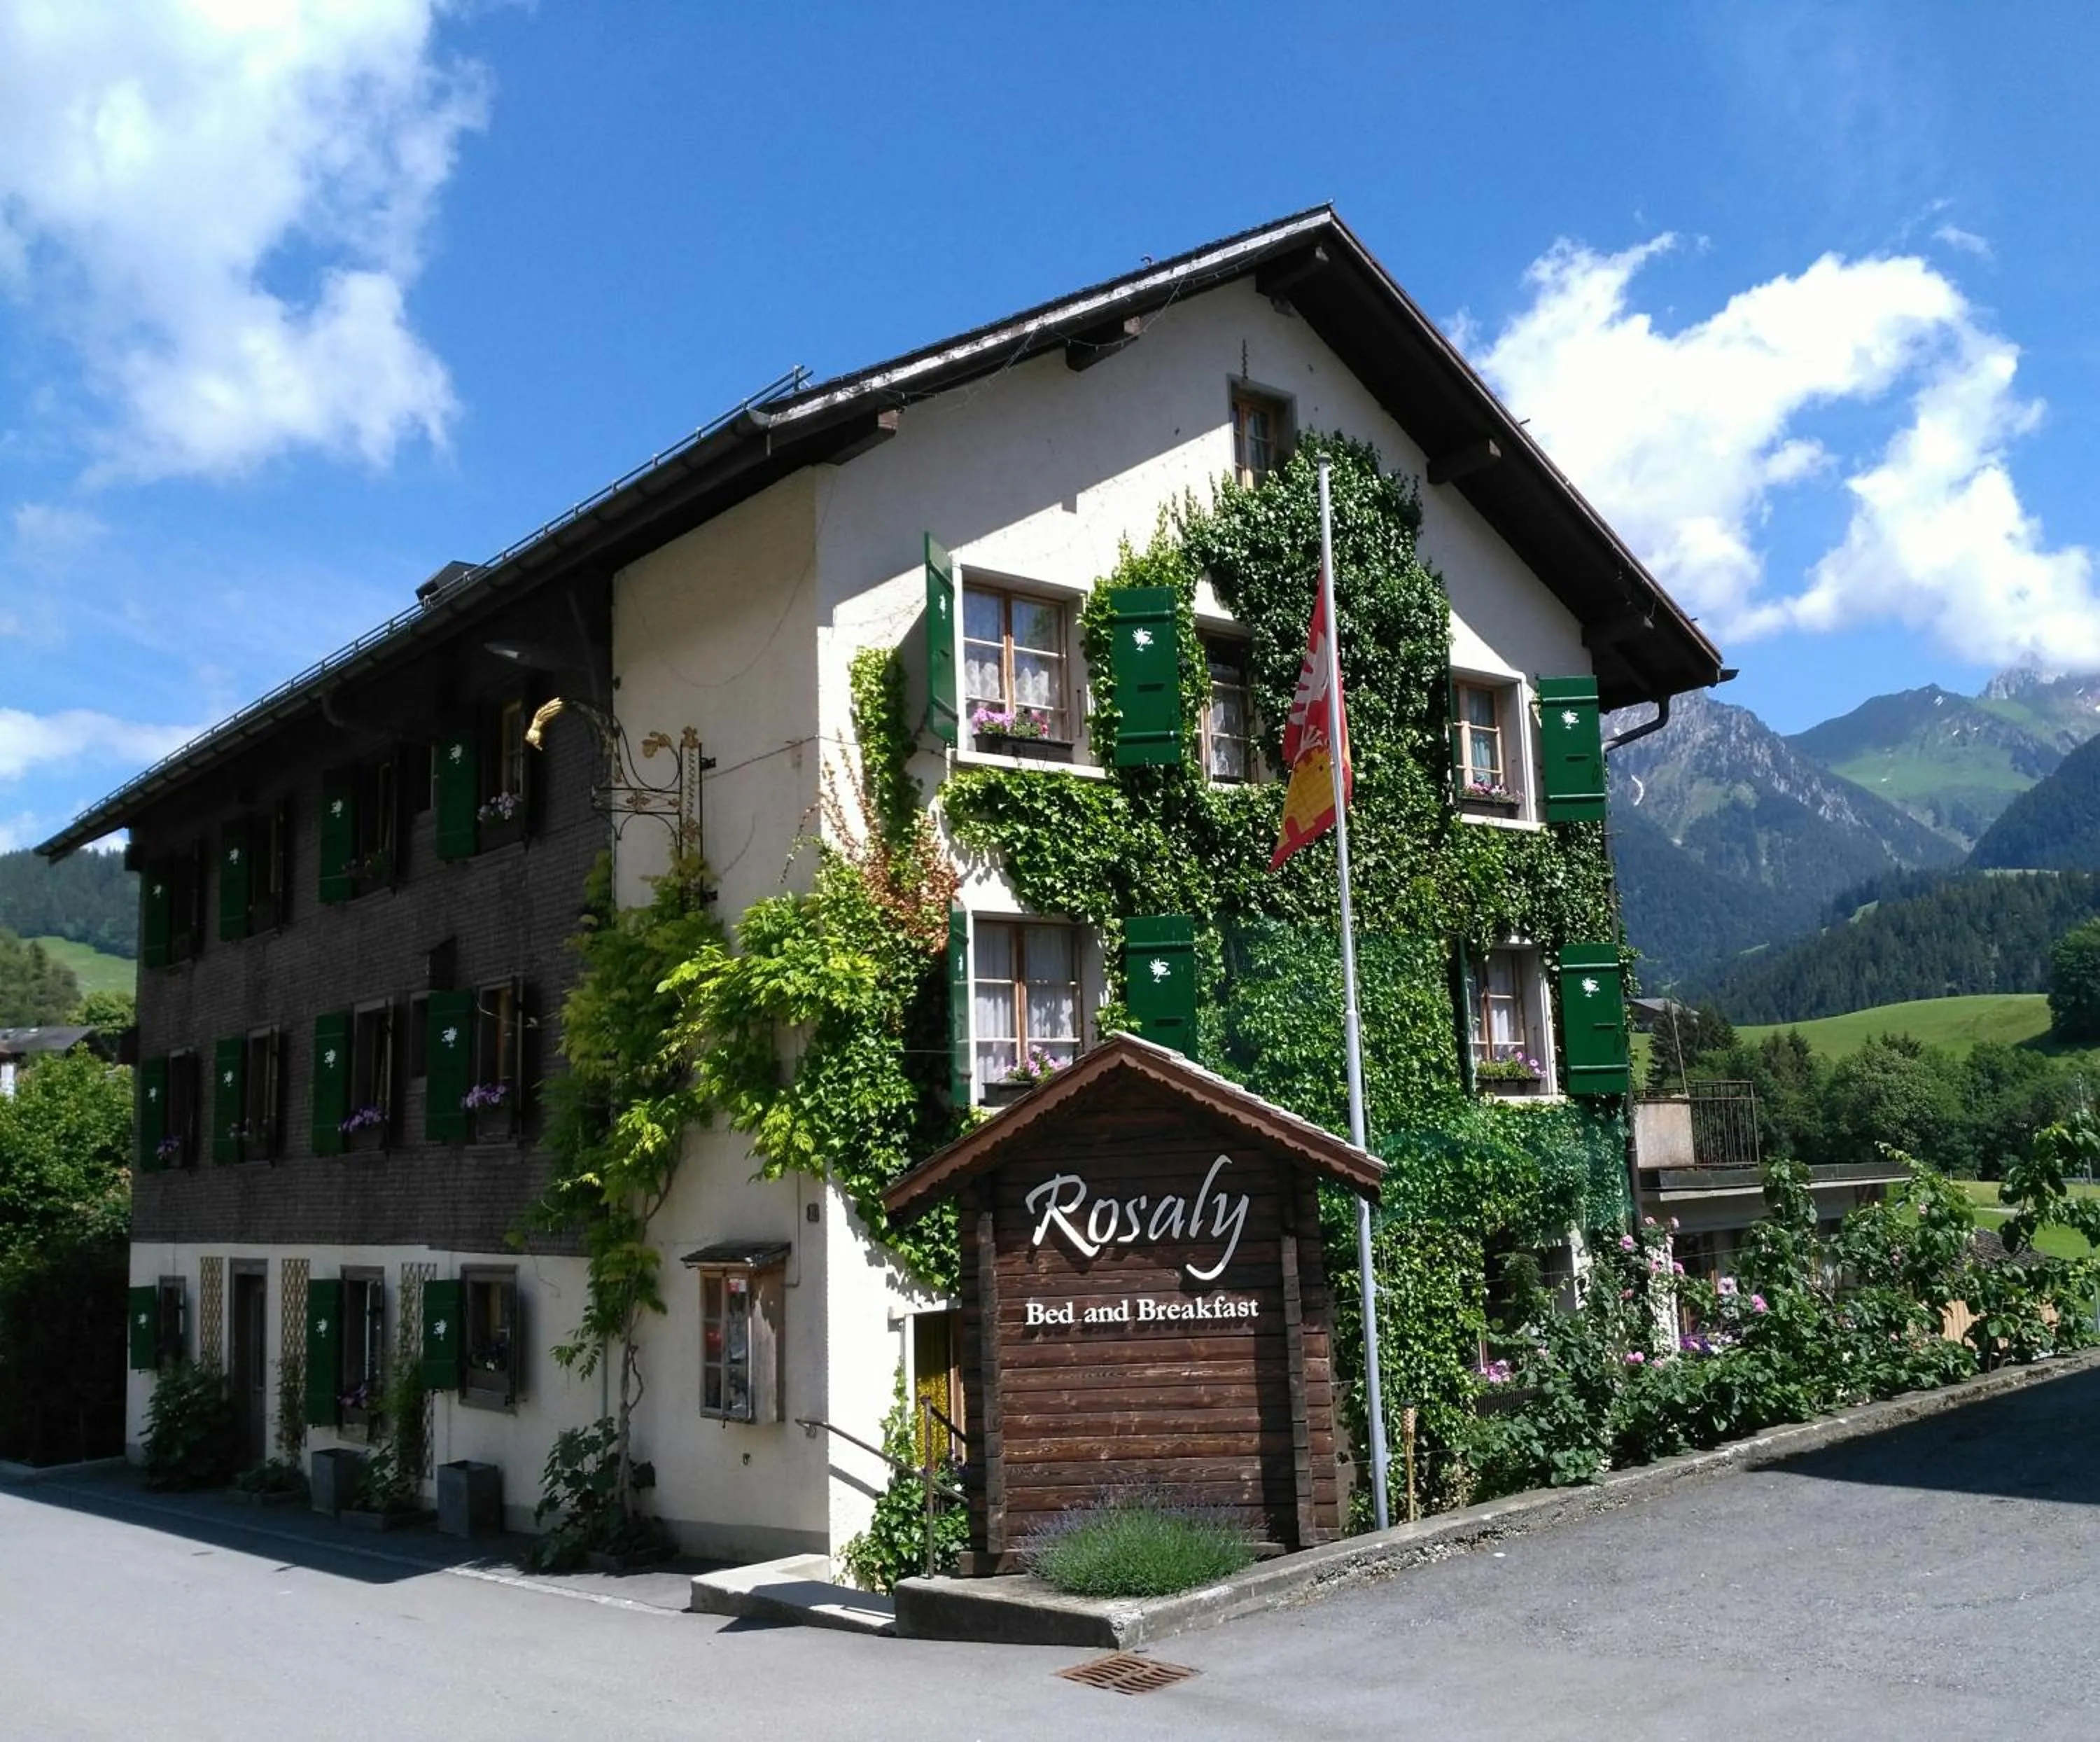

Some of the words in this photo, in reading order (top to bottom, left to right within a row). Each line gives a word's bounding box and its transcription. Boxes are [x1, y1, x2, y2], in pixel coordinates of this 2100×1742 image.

[1025, 1155, 1250, 1281] Rosaly
[1026, 1301, 1074, 1325] Bed
[1084, 1299, 1130, 1323] and
[1136, 1295, 1259, 1321] Breakfast
